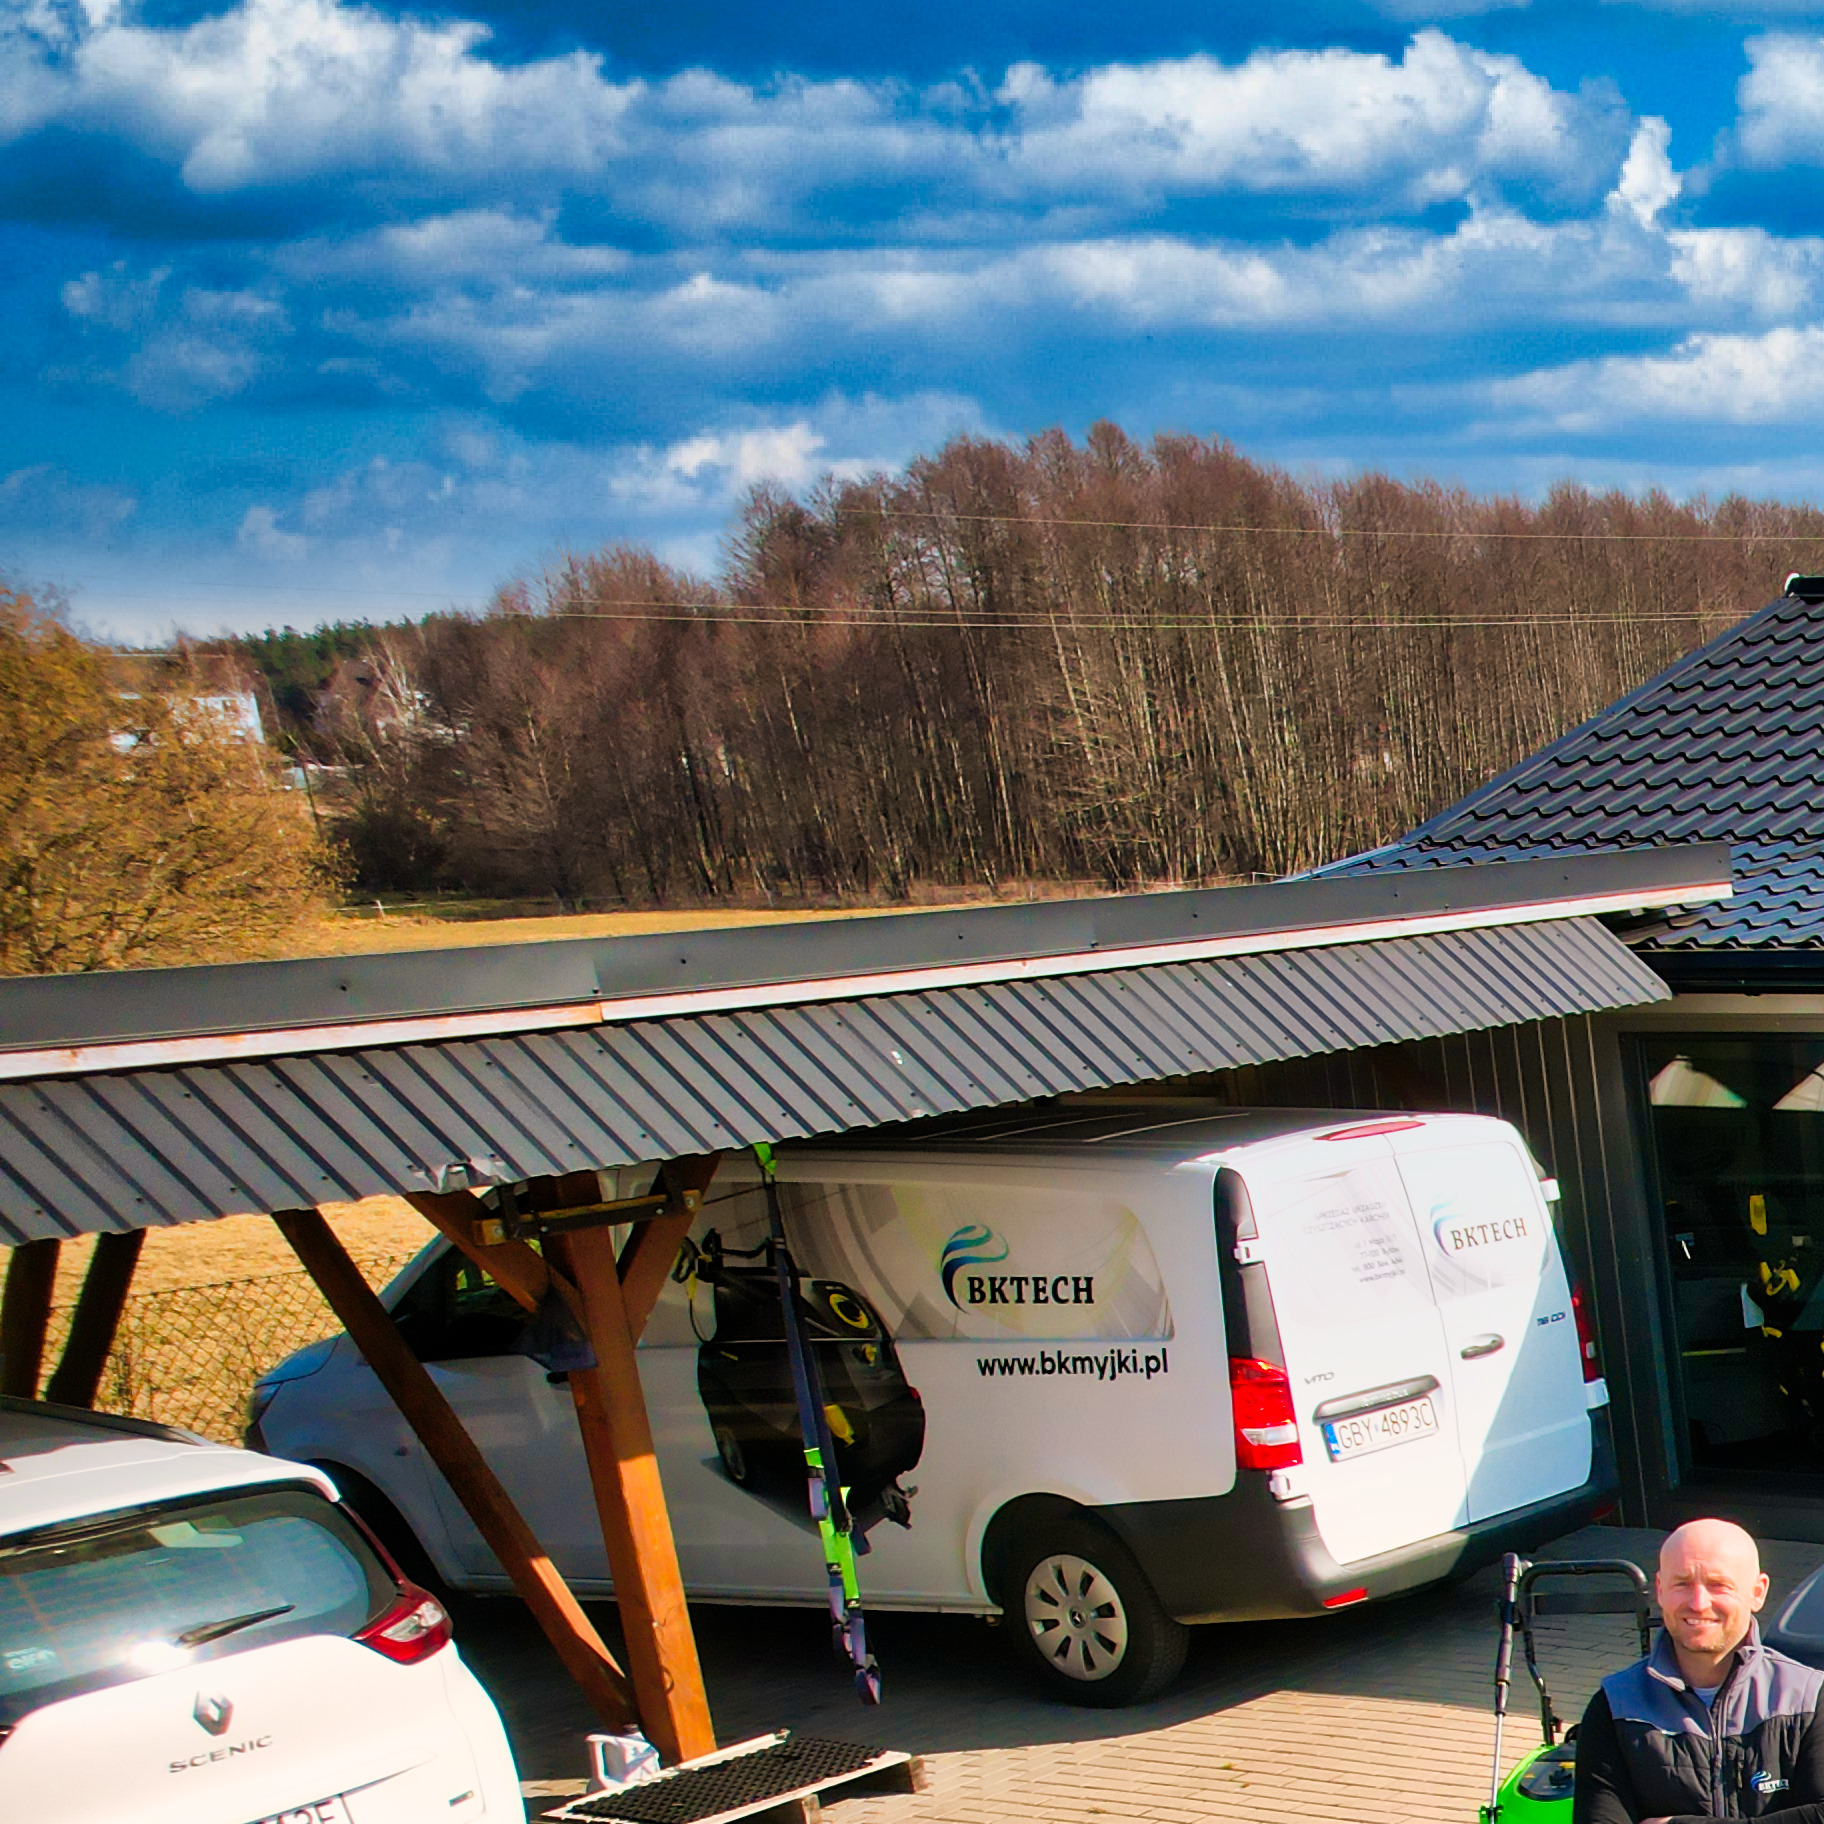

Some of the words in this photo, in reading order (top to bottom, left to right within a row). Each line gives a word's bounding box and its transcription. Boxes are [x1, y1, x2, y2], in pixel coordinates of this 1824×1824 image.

[1450, 1217, 1528, 1251] BKTECH
[967, 1276, 1095, 1304] BKTECH
[976, 1347, 1168, 1381] www.bkmyjki.pl
[1338, 1418, 1373, 1449] GBY
[1382, 1403, 1434, 1436] 4893C
[169, 1735, 273, 1773] SCENIC
